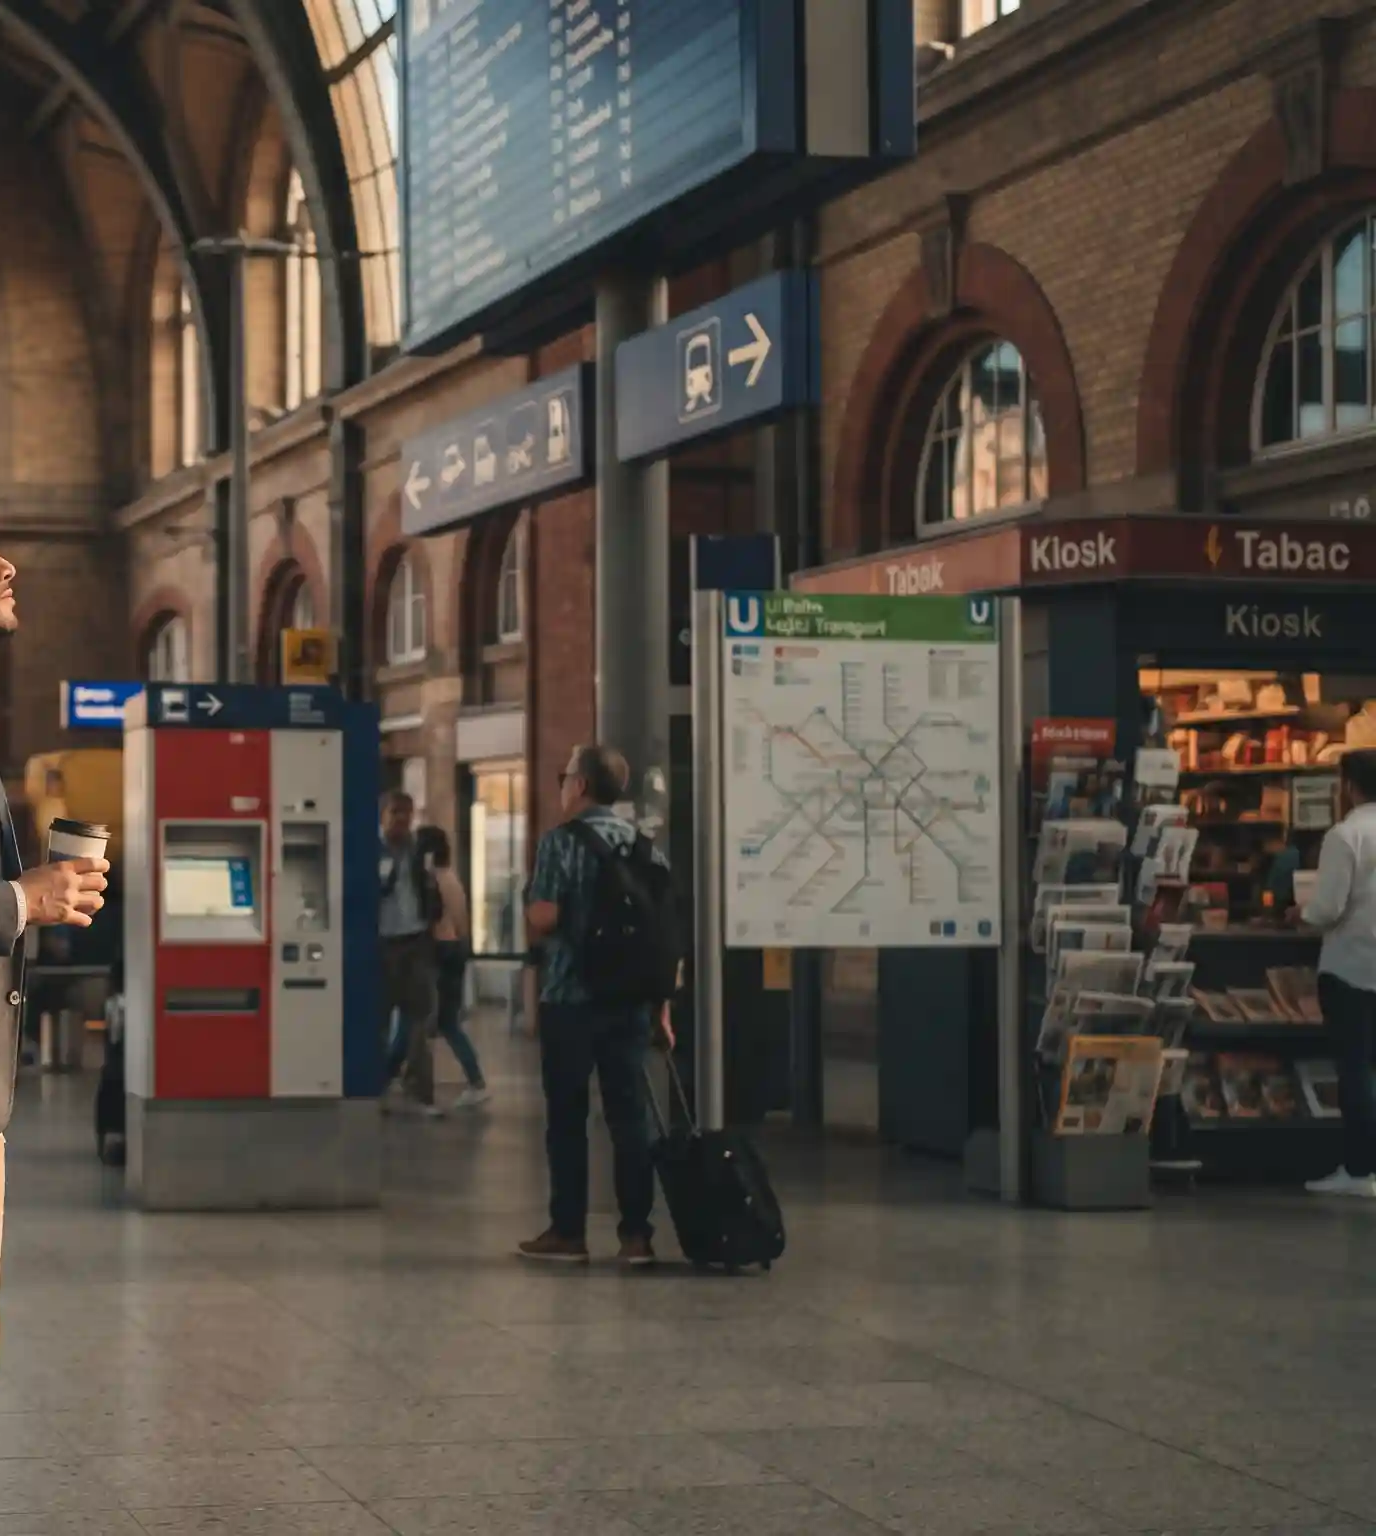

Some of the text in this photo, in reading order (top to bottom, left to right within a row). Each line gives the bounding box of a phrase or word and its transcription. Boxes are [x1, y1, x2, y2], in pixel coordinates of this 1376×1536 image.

[1032, 531, 1350, 571] Kiosk Tabac
[729, 597, 759, 633] U
[971, 600, 990, 623] U
[1226, 605, 1321, 637] Kiosk
